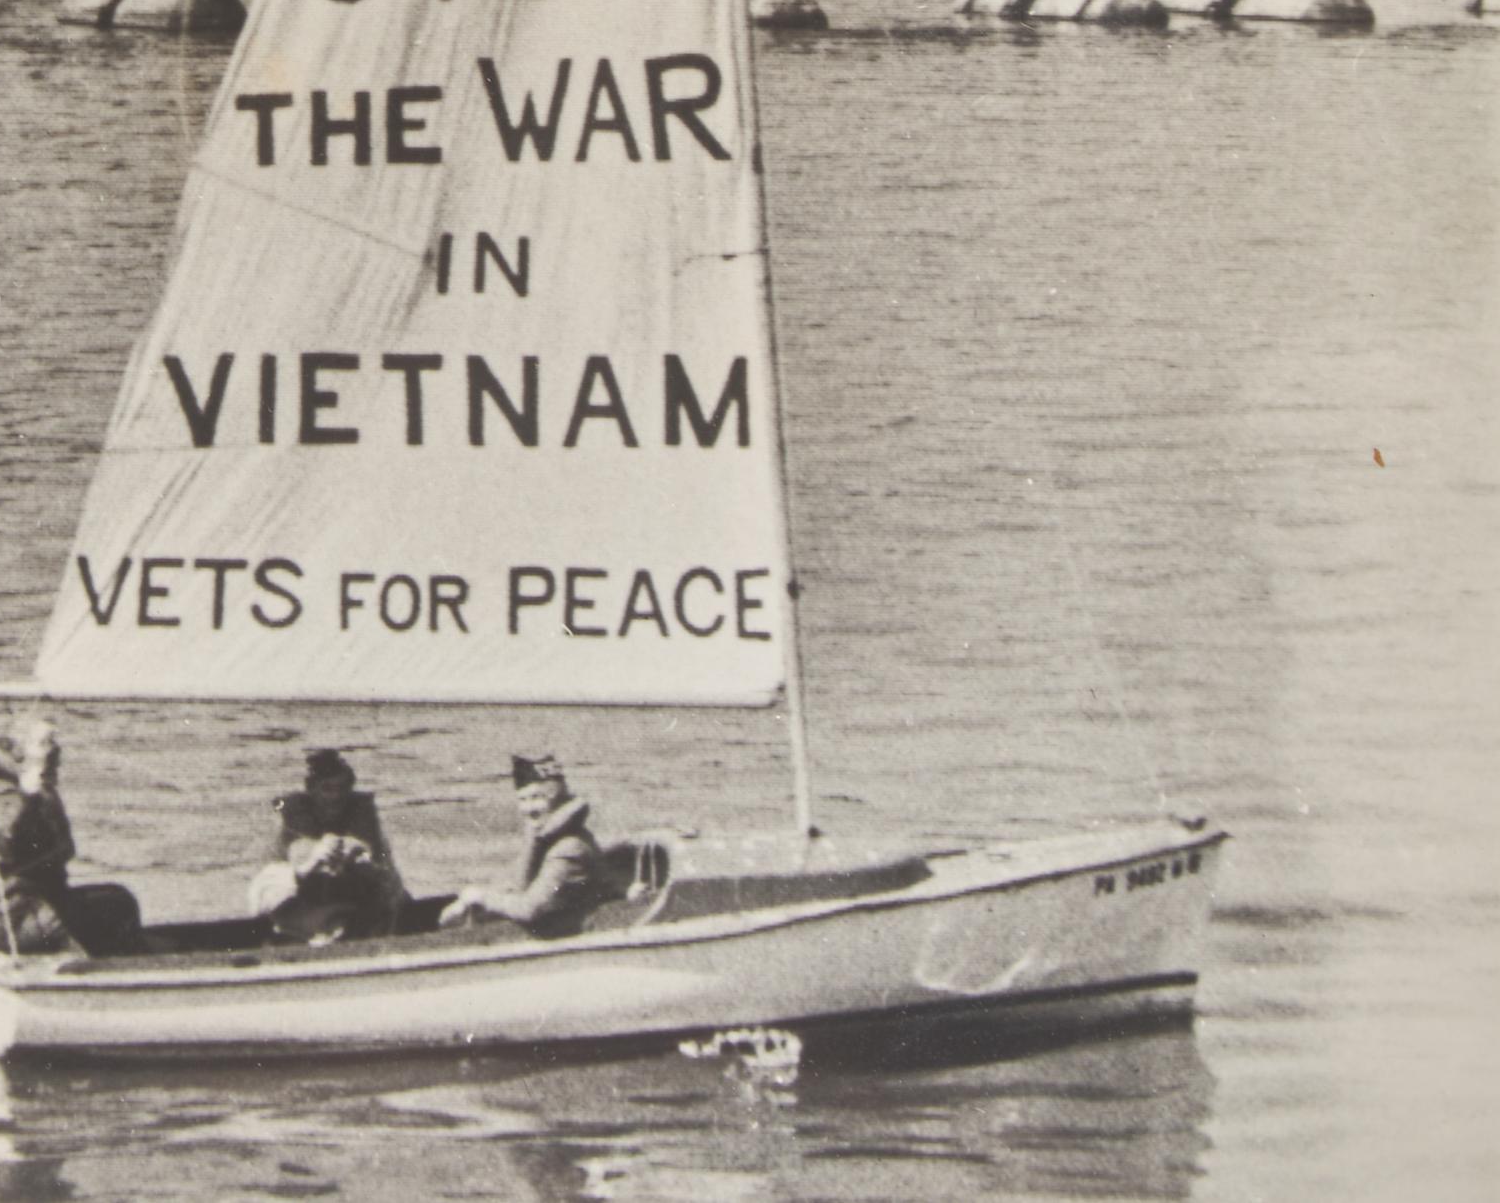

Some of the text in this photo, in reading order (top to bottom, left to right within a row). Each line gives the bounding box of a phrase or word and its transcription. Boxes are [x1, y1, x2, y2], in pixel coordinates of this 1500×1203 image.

[235, 52, 733, 166] THE WAR
[436, 231, 530, 298] IN
[163, 352, 751, 448] VIETNAM
[77, 555, 773, 641] VETS FOR PEACE
